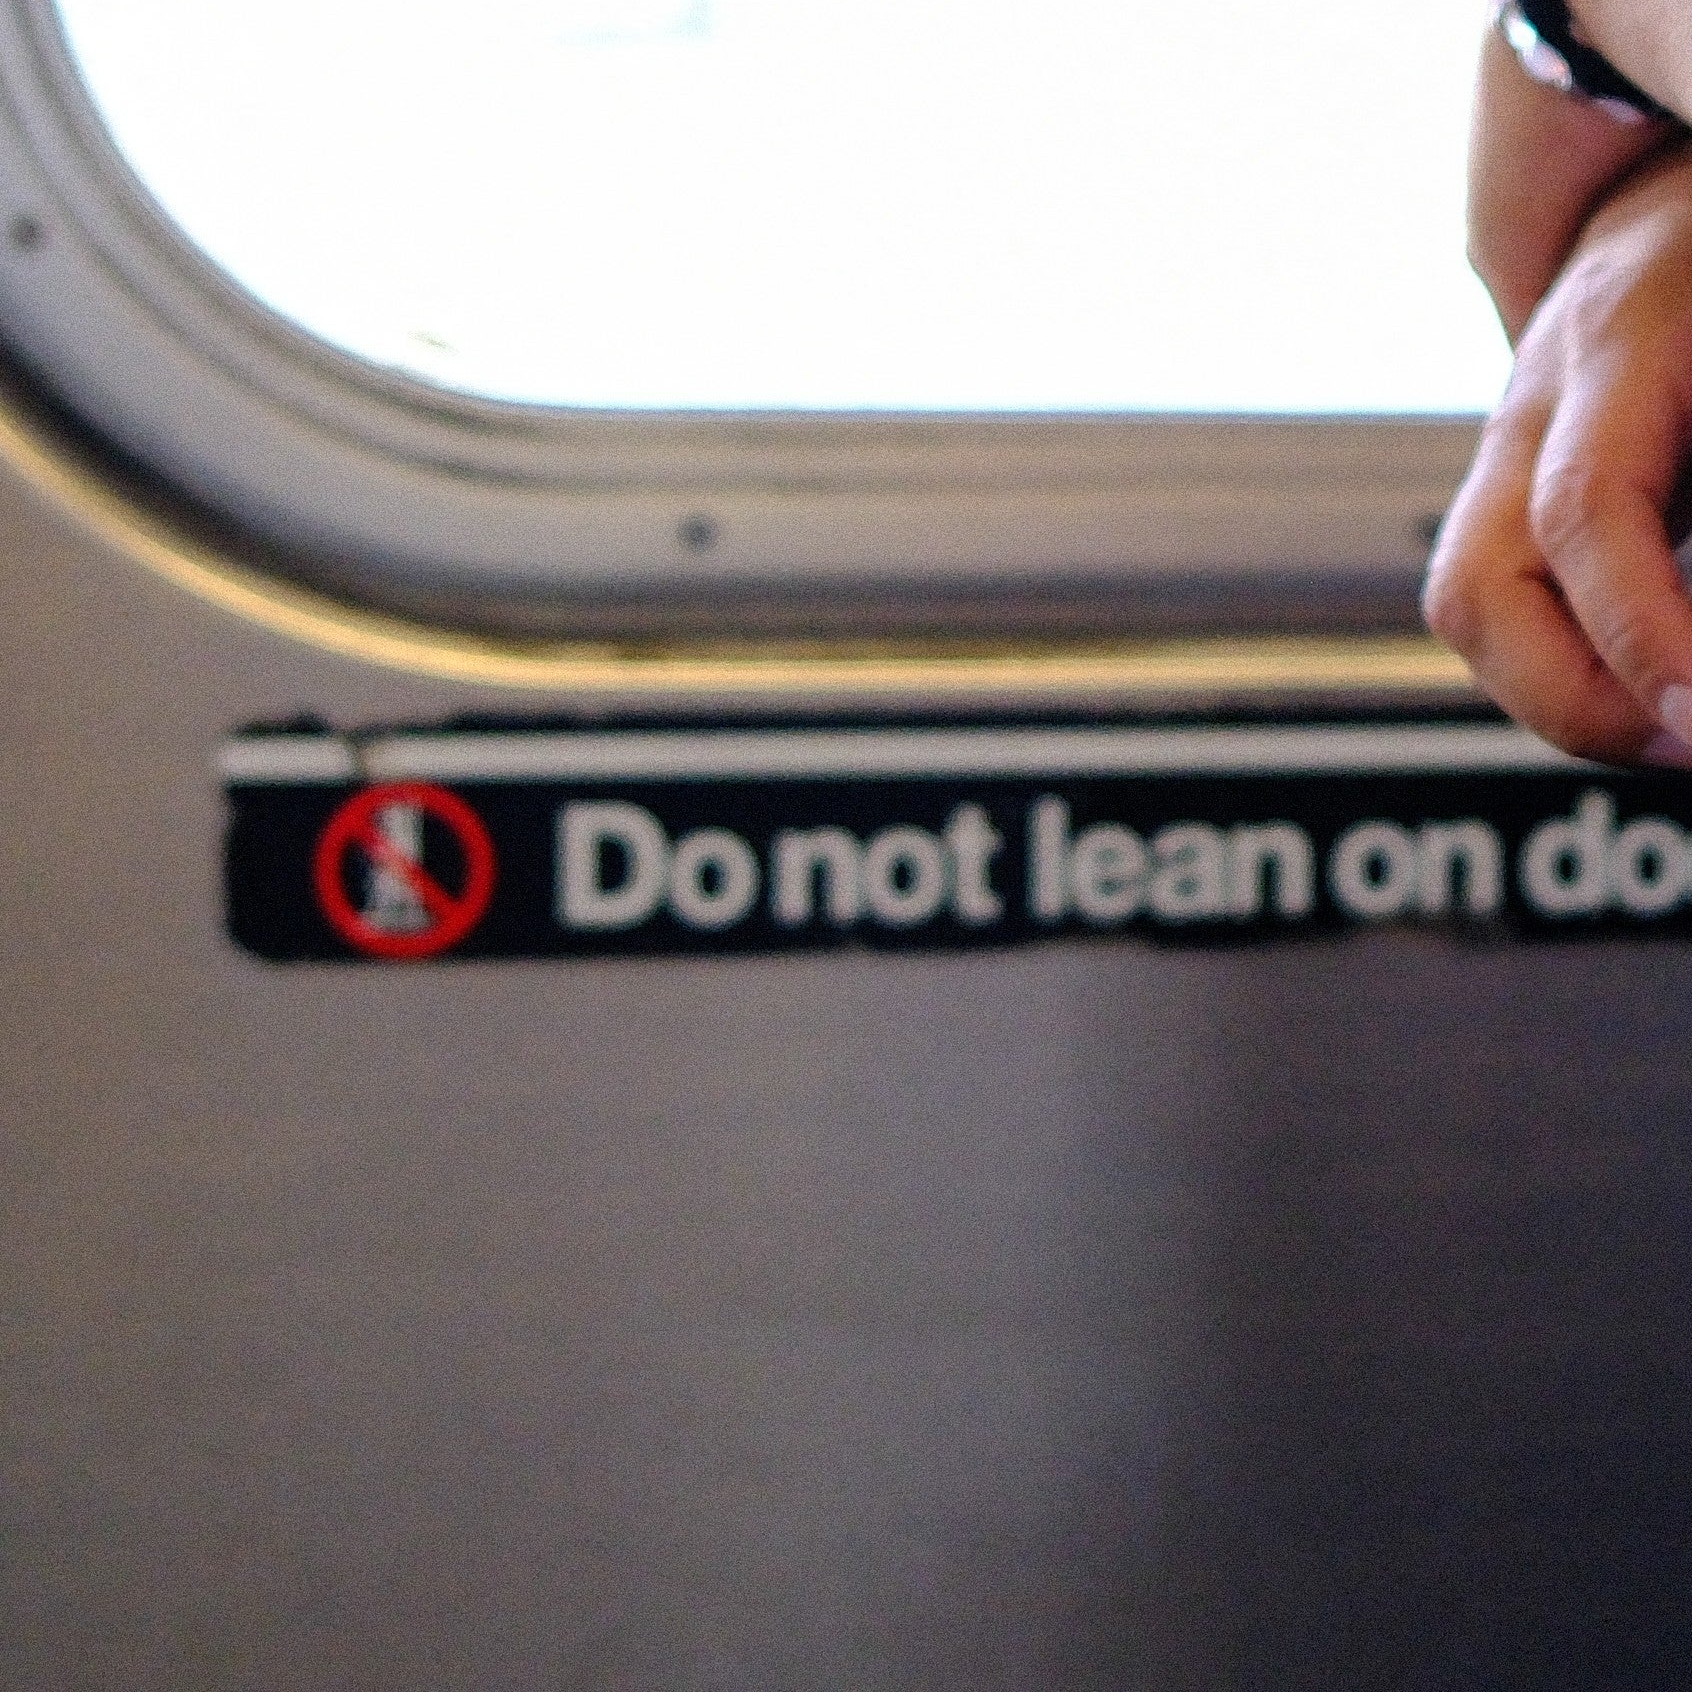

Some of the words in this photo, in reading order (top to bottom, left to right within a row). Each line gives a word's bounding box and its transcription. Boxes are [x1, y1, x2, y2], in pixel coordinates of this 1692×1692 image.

[556, 799, 760, 929] Do
[772, 802, 1002, 926] not
[1029, 796, 1314, 921] lean
[1330, 820, 1503, 919] on
